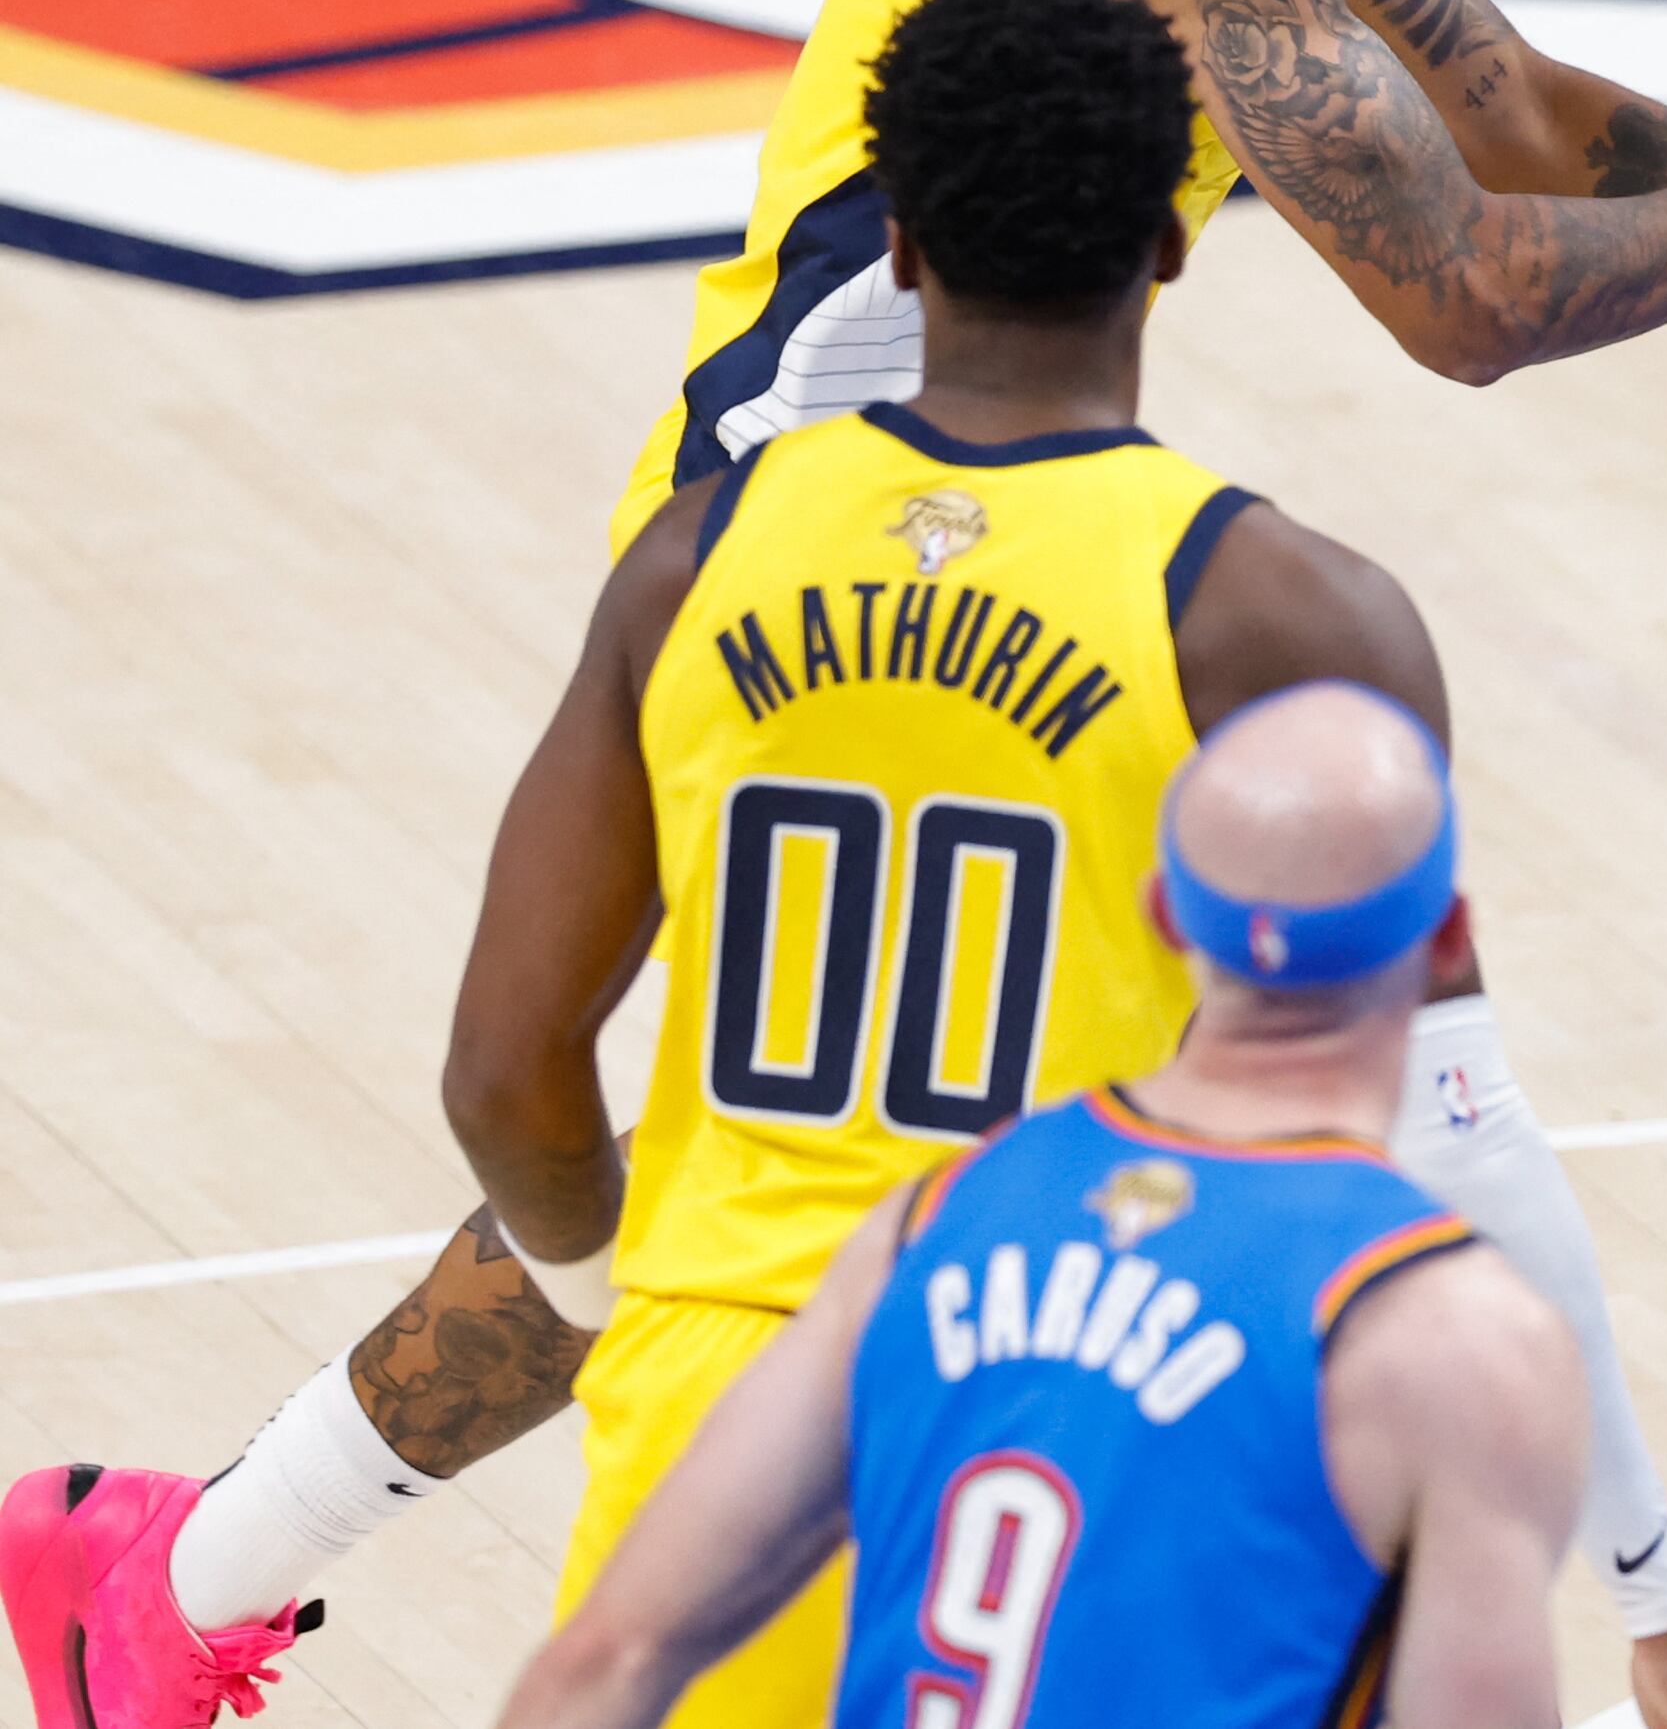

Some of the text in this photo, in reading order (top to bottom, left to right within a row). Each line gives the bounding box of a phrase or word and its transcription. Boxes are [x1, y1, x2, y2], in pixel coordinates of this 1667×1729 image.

[1464, 57, 1509, 110] 444
[714, 581, 1128, 760] MATHURIN
[702, 771, 1068, 1145] 00
[926, 1240, 1246, 1427] CARUSO
[905, 1448, 1084, 1729] 9
